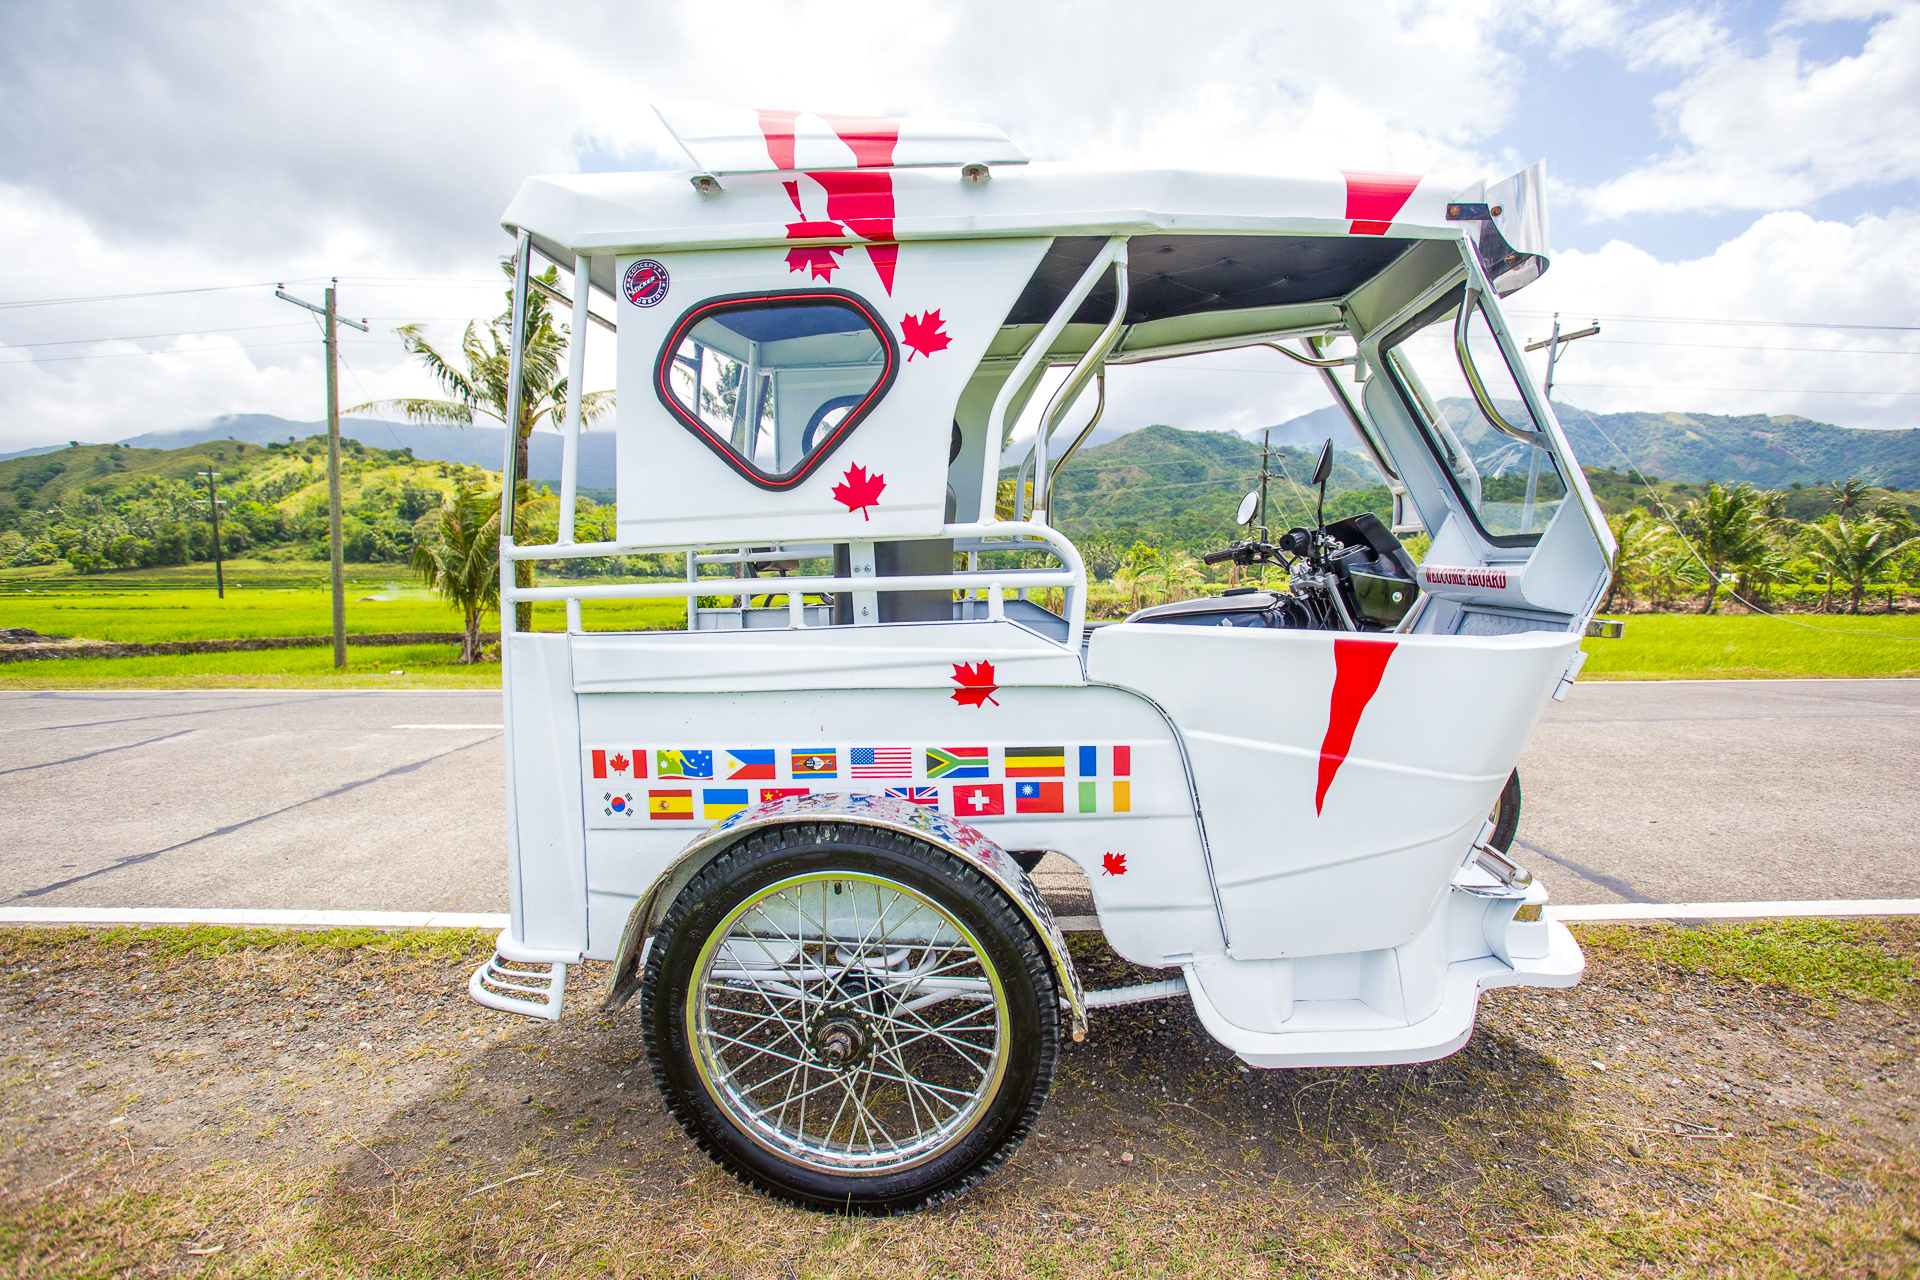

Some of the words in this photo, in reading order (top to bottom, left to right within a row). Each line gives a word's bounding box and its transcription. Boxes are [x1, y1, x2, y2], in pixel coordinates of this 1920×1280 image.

[631, 275, 656, 296] STICKER
[1425, 567, 1466, 586] WELCOME
[1466, 569, 1507, 589] ABOARD
[915, 1130, 990, 1187] SAPPHIRE
